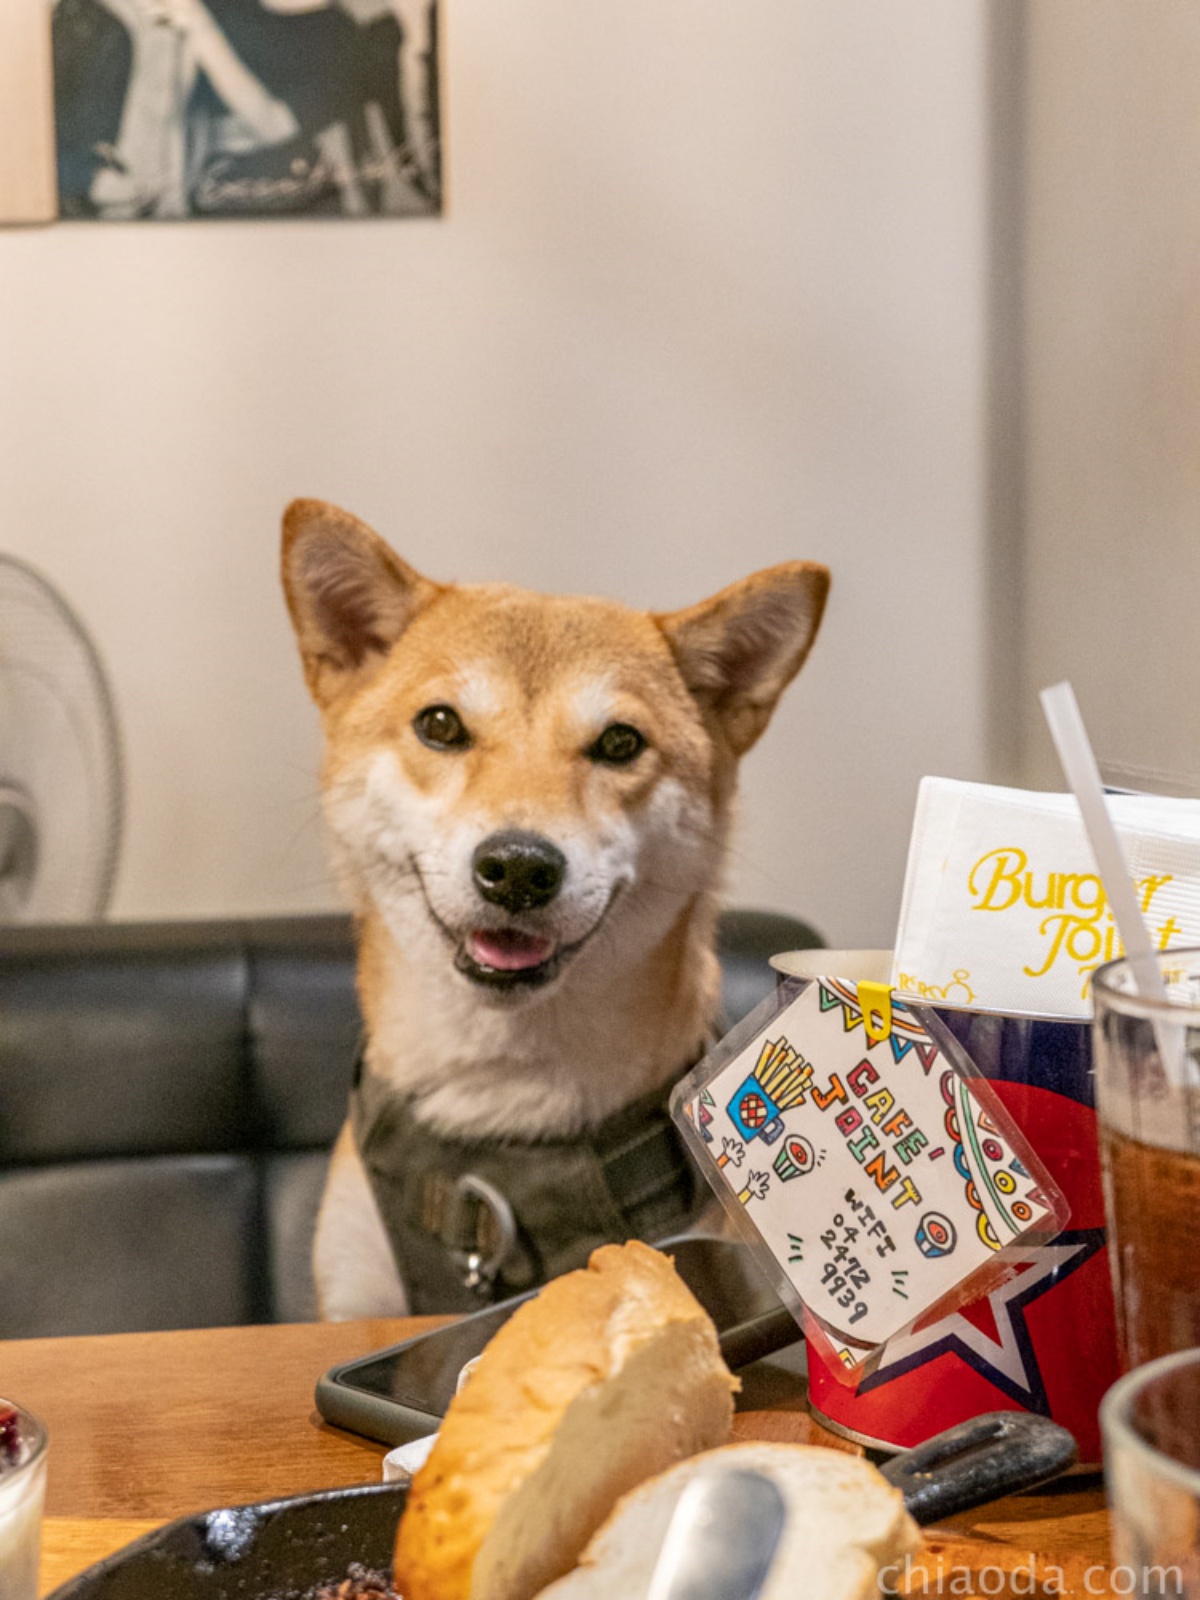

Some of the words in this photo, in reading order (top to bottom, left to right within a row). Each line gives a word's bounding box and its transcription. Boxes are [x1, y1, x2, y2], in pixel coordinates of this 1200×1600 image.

[968, 847, 1173, 923] Burgr
[1022, 914, 1182, 977] Joit
[810, 1073, 923, 1210] JOINT
[833, 1213, 859, 1244] 04
[844, 1188, 896, 1258] WIFI
[820, 1229, 871, 1290] 2472
[820, 1263, 868, 1325] 9939
